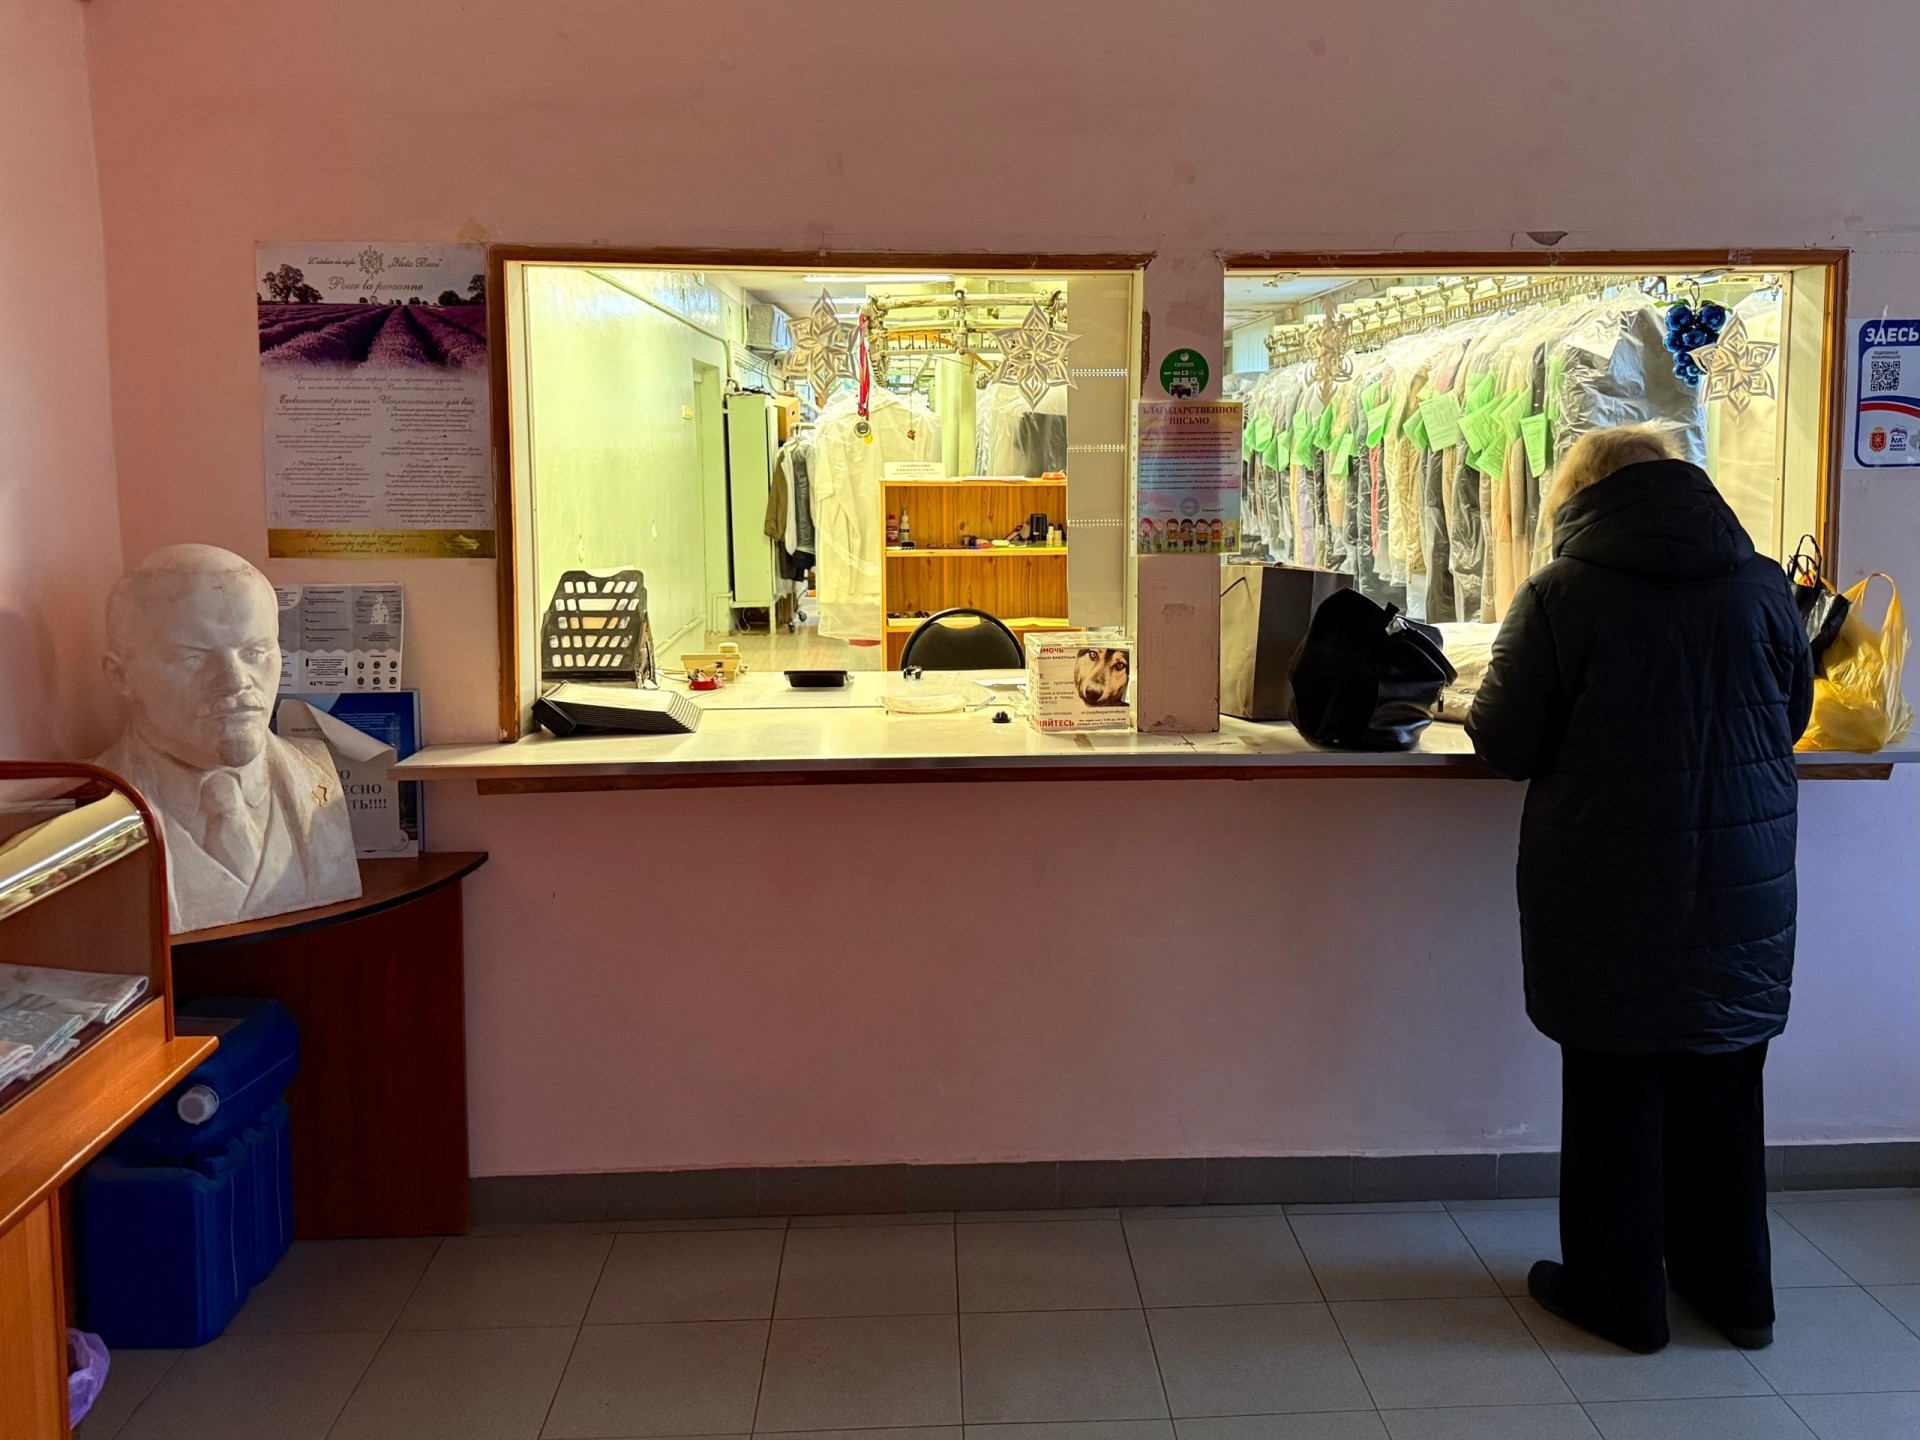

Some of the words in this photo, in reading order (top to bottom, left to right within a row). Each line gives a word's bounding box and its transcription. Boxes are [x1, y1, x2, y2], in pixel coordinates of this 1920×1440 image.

[328, 275, 361, 290] Pour
[362, 278, 374, 290] la
[373, 280, 424, 295] personne
[1864, 326, 1920, 345] ЗДЕСЬ
[1142, 406, 1239, 415] БЛАГОДАРСТВЕННОЕ
[1169, 416, 1210, 425] ПИСЬМО
[343, 783, 382, 795] ЕСНО
[349, 798, 387, 810] ТЬ!!!!
